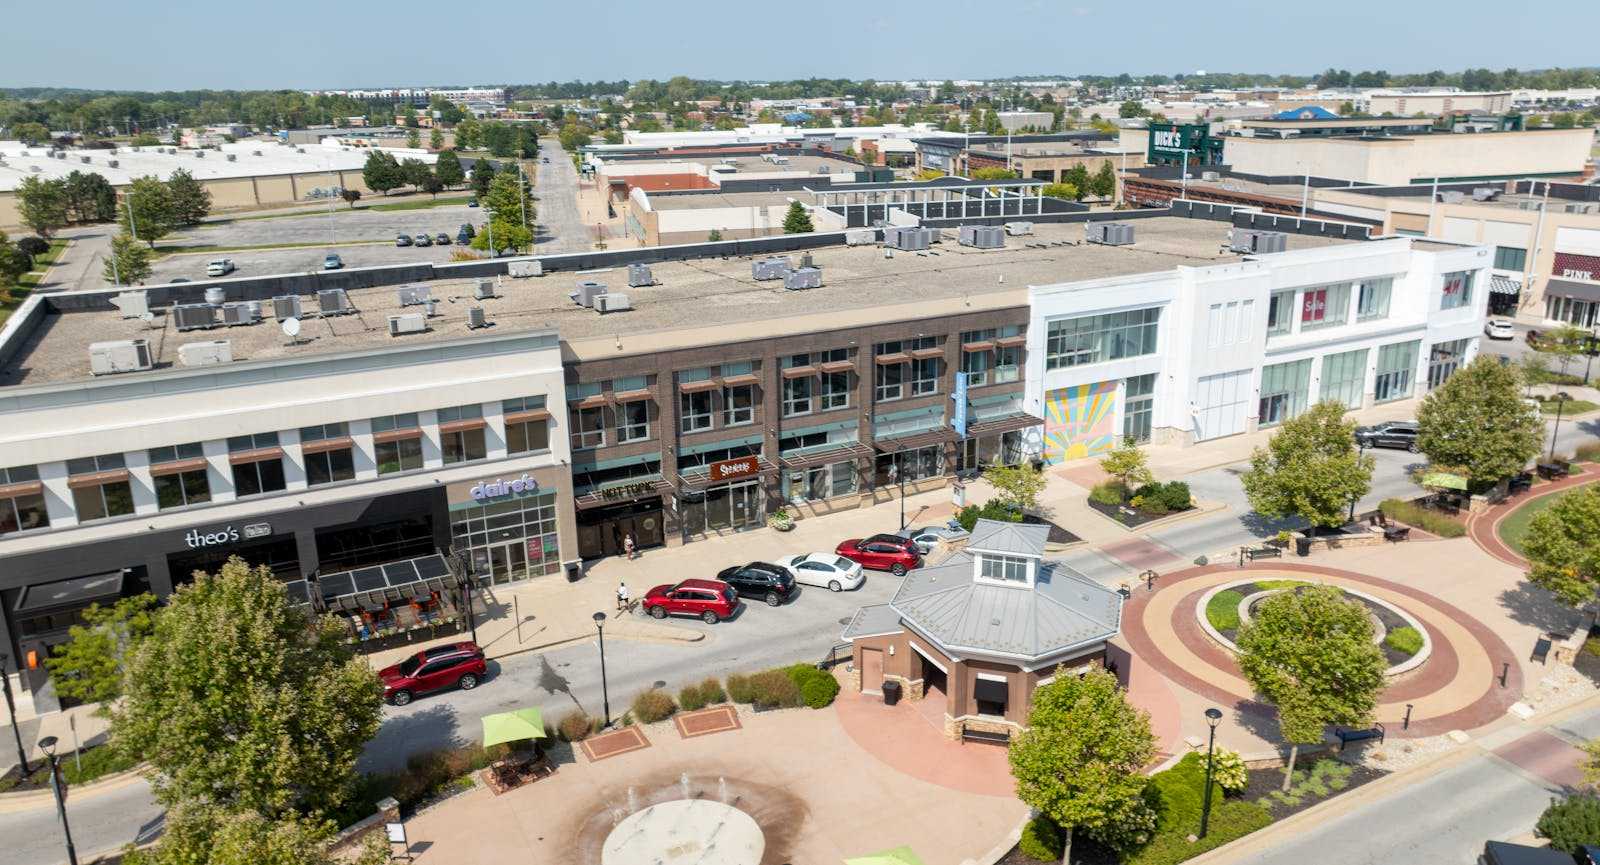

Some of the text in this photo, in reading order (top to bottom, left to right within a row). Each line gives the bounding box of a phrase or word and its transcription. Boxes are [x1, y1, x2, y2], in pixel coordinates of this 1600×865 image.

[1155, 131, 1181, 147] DICK'S
[1563, 268, 1593, 281] PINK
[1305, 300, 1326, 312] Sale
[470, 473, 536, 500] claire's
[185, 525, 240, 547] theo's
